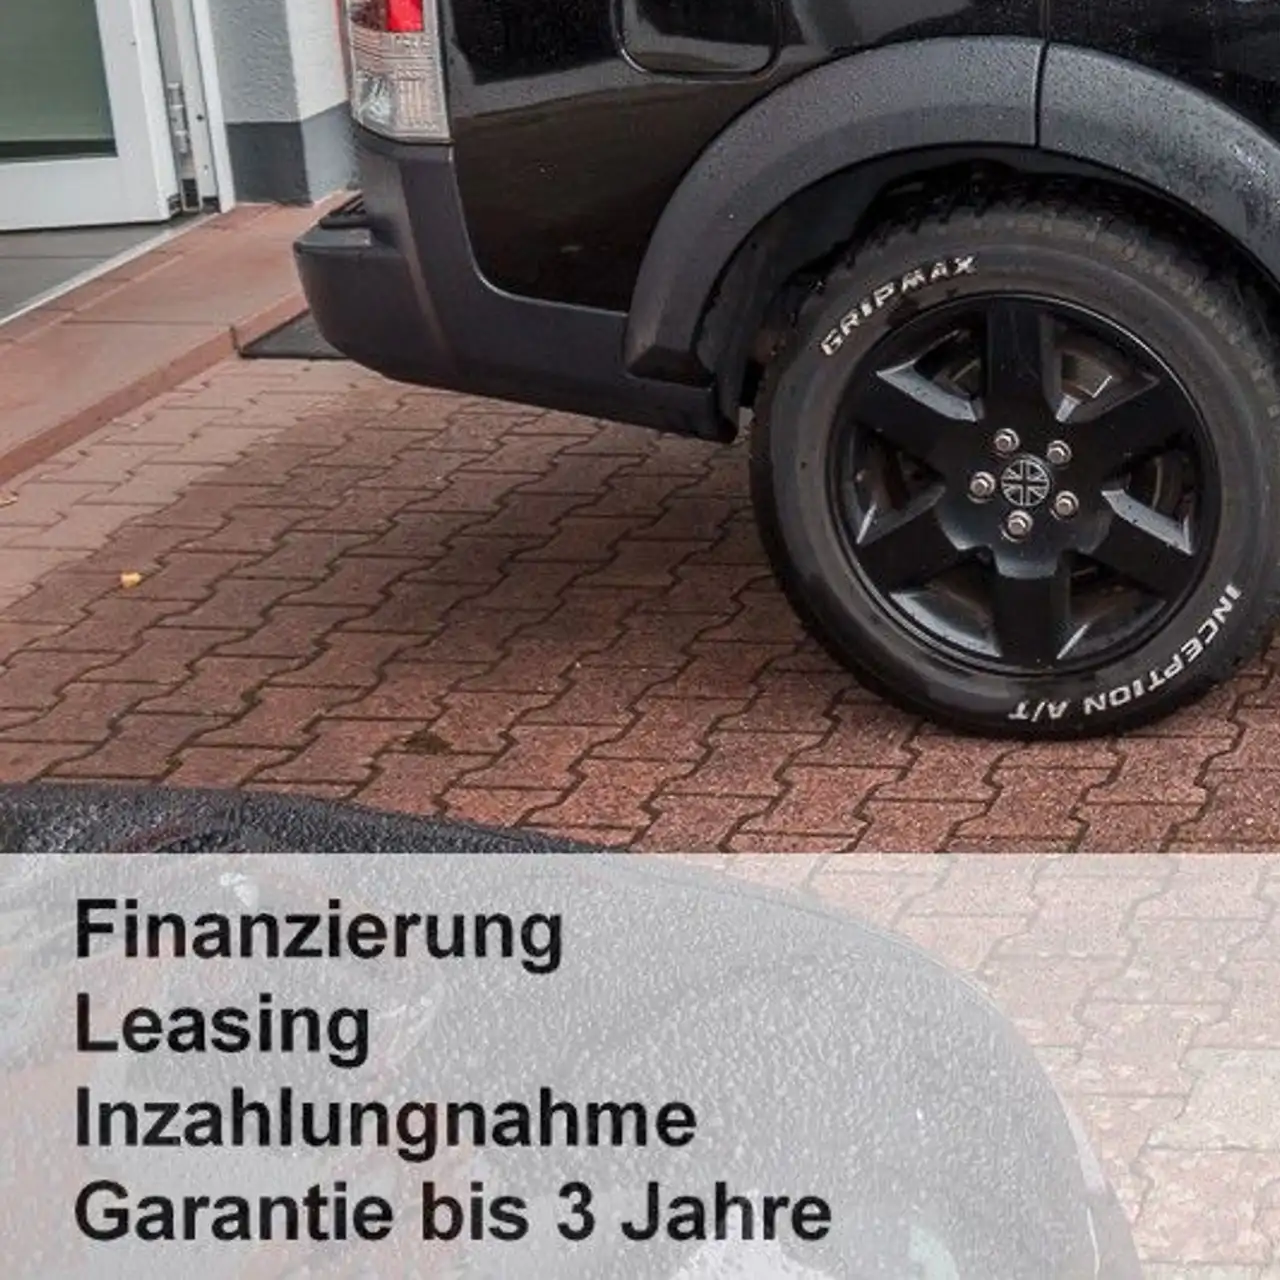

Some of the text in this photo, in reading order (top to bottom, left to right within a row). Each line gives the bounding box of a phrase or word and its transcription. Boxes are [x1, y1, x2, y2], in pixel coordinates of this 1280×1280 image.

[820, 255, 978, 357] GRIPMAX
[1009, 582, 1242, 723] INCEPTION A/T
